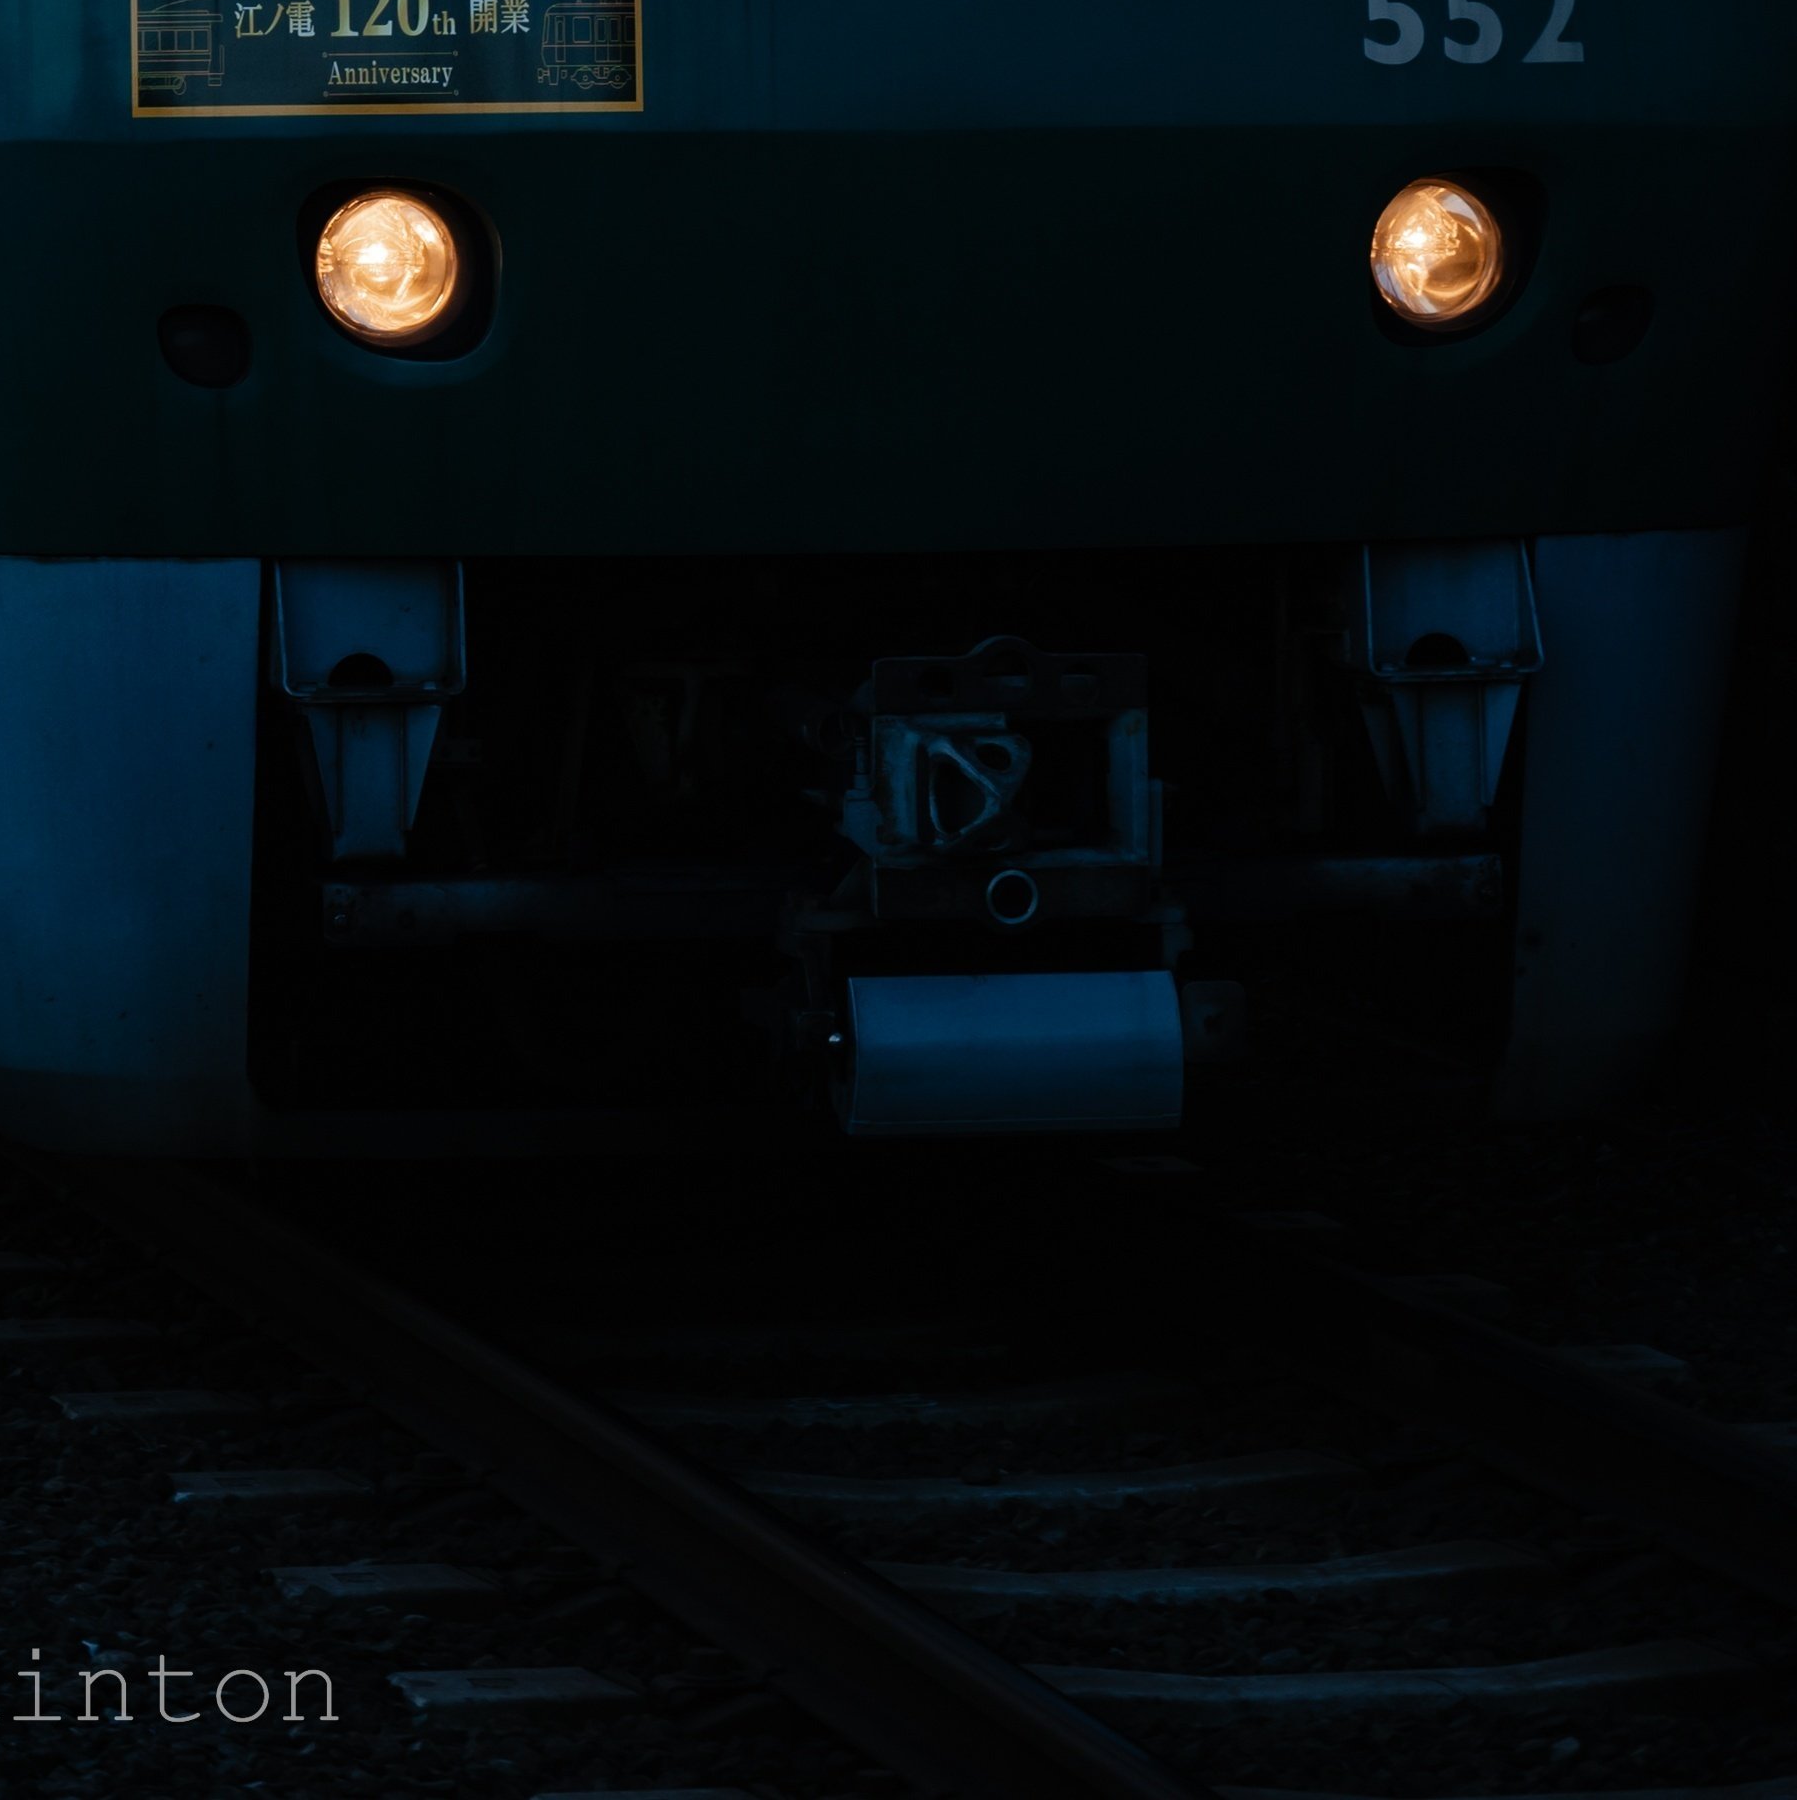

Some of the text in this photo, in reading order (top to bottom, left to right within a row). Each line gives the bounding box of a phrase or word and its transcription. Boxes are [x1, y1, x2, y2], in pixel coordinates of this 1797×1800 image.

[233, 0, 316, 39] 江ノ電
[327, 60, 454, 87] Anniversary
